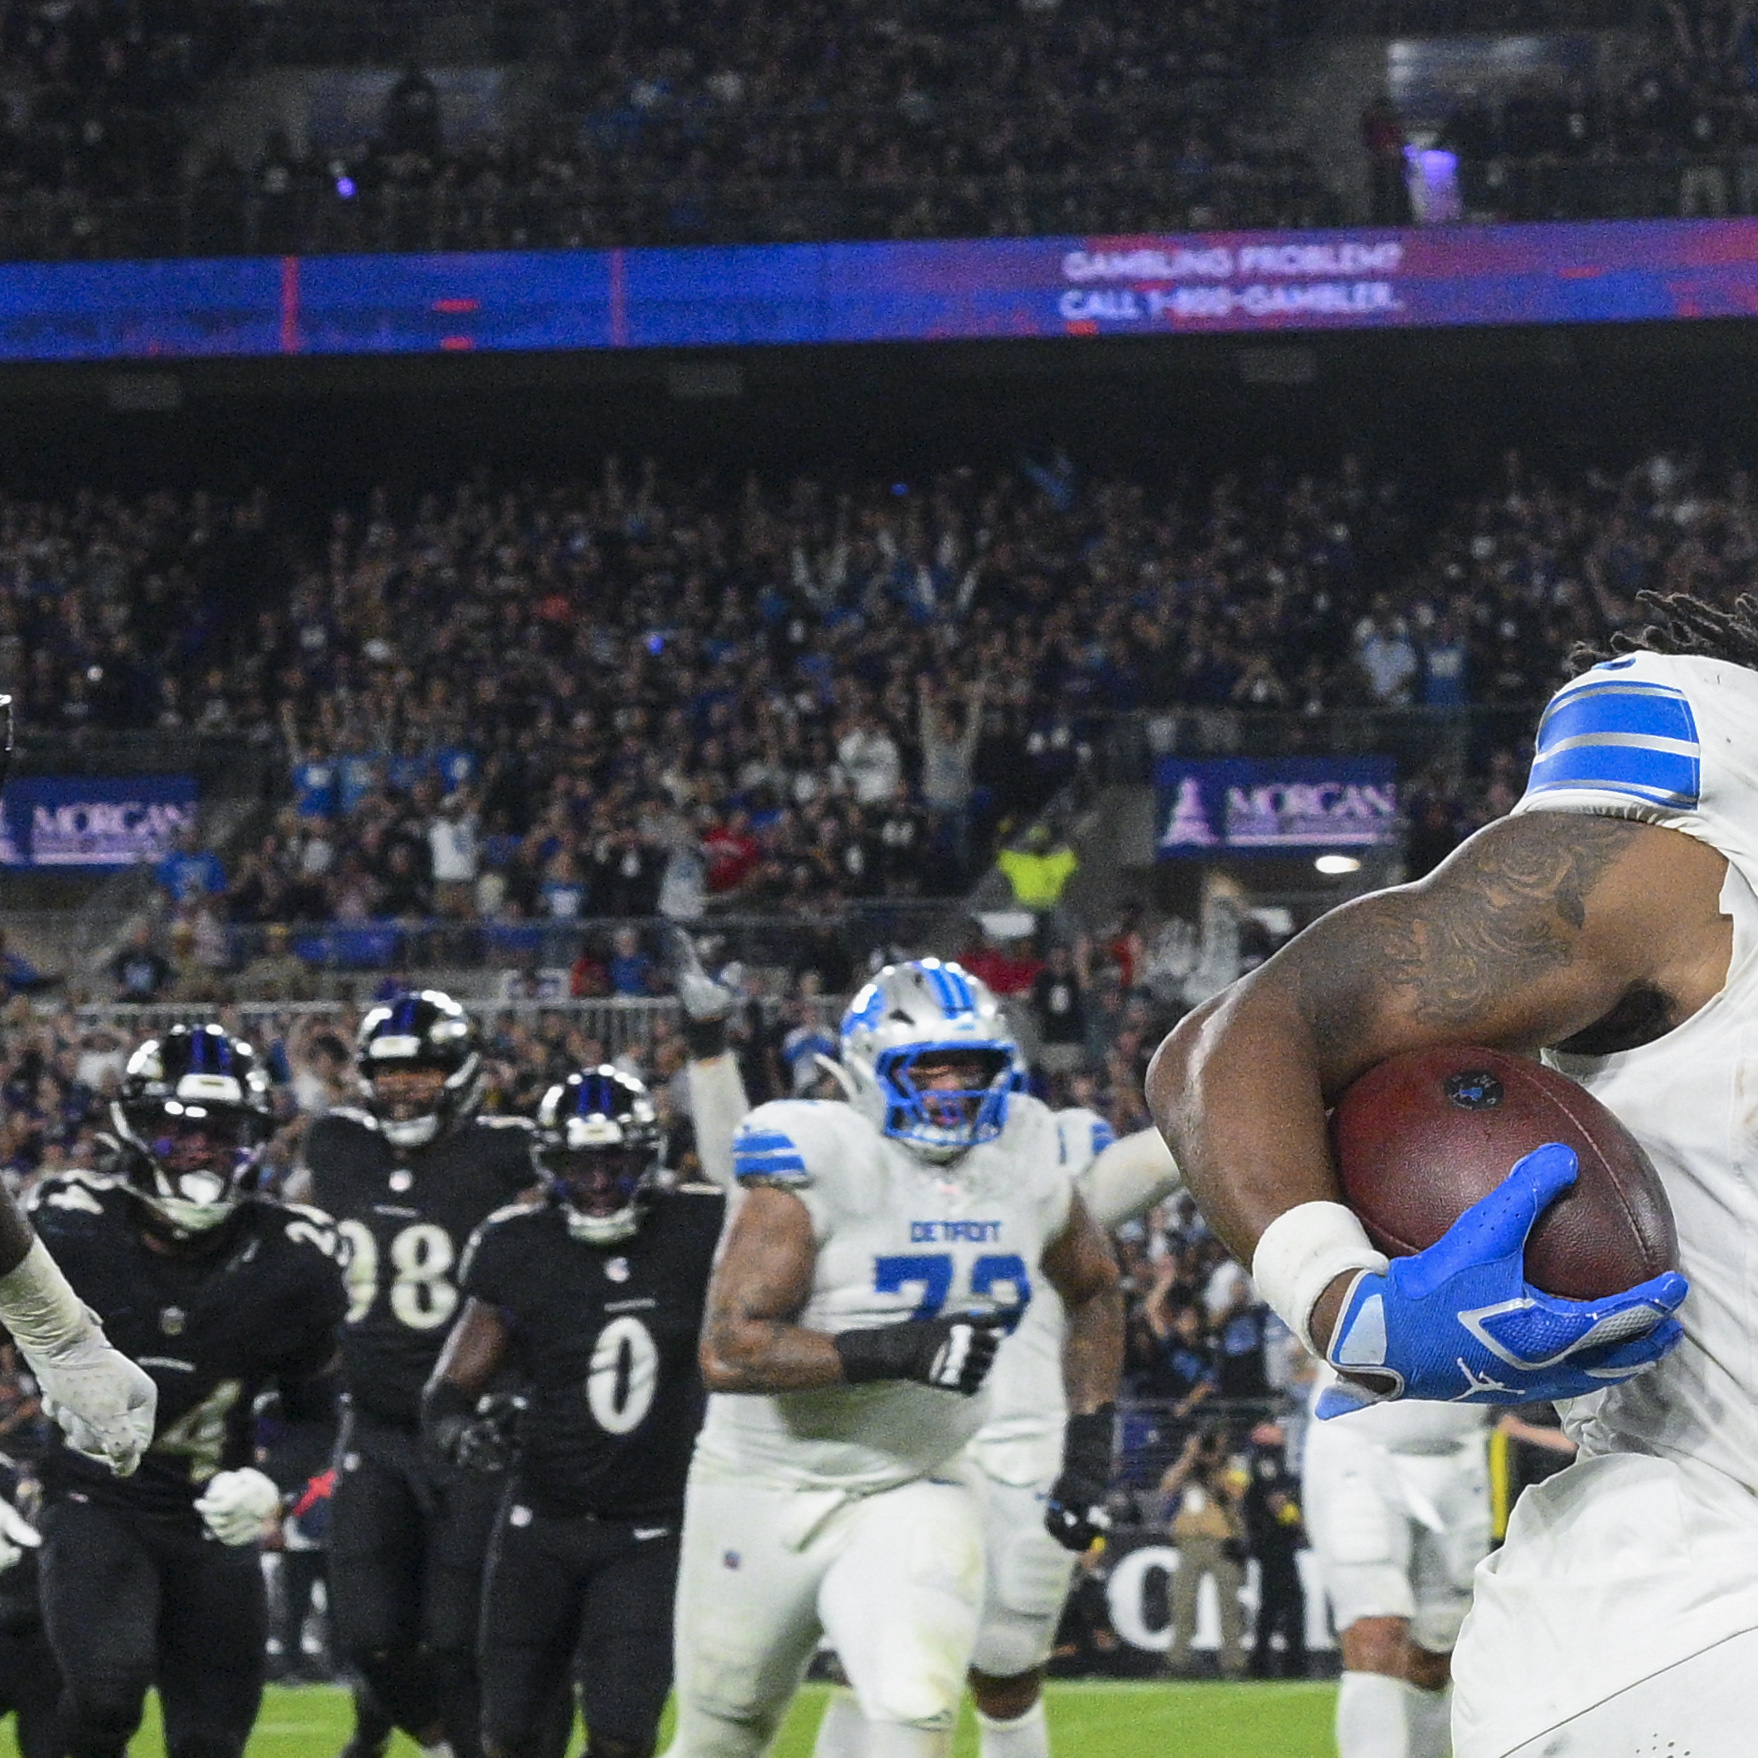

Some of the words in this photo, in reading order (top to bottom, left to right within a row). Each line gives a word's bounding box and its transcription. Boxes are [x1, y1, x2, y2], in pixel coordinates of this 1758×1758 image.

[1226, 780, 1398, 817] MORGAN
[910, 1219, 1003, 1244] DETROIT
[336, 1219, 458, 1330] 98
[586, 1315, 660, 1435] 0
